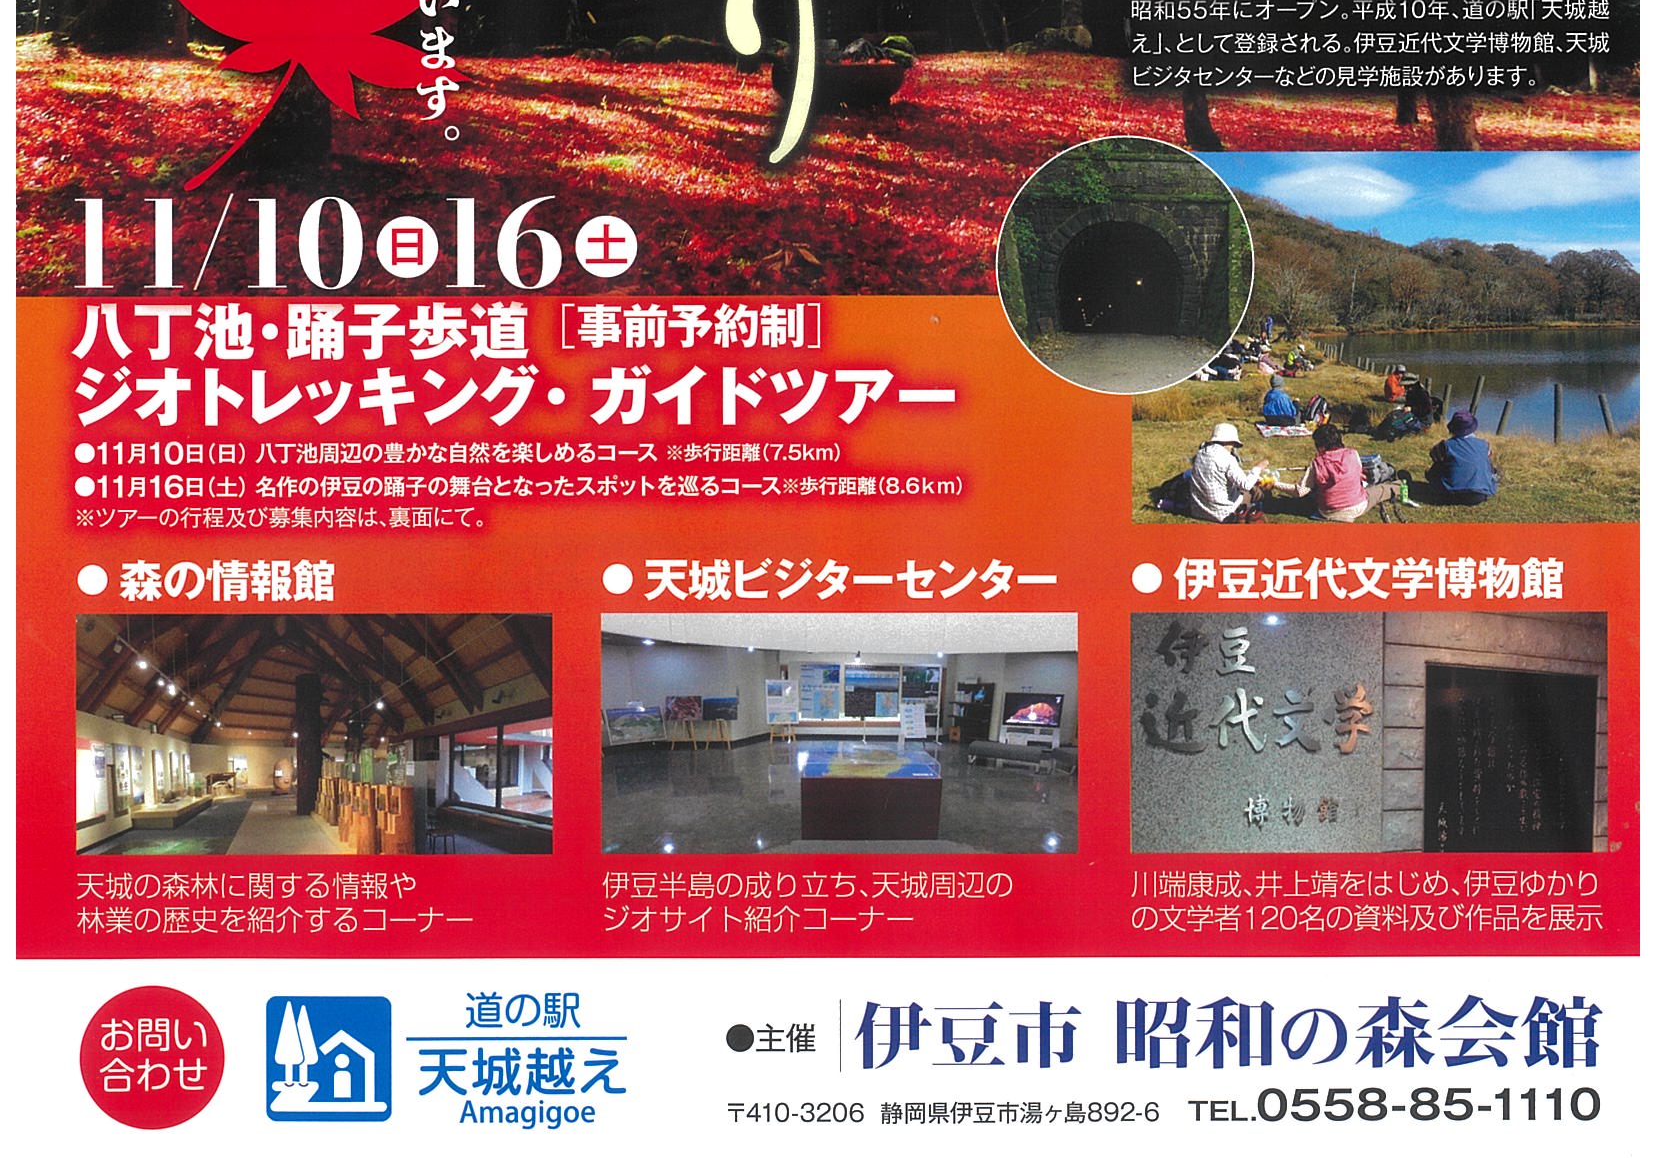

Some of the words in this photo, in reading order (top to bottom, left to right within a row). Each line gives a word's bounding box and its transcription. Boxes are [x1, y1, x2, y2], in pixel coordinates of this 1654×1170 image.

[1131, 31, 1611, 55] え」、として登録される。伊豆近代文学博物館、天城
[1132, 64, 1537, 88] ビジタセンターなどの見学施設があります。
[74, 193, 364, 291] 11/10
[445, 193, 563, 291] 16
[72, 302, 530, 361] 八丁池・踊子歩道
[256, 442, 658, 464] 八丁池周辺の豊かな自然を楽しめるコース
[76, 506, 485, 529] ※ツアーの行程及び募集内容は、裏面にて。
[119, 559, 336, 601] 森の情報館
[644, 558, 1057, 601] 天城ビジターセンター
[1174, 557, 1564, 600] 伊豆近代文学博物館
[1156, 621, 1256, 676] 伊豆
[1140, 683, 1374, 756] 近代文学
[76, 872, 417, 901] 天城の森林に関する情報や
[602, 872, 1014, 901] 伊豆半島の成り立ち、天城周辺の
[1131, 871, 1599, 900] 川端康成、井上靖をはじめ、伊豆ゆかり
[76, 906, 474, 934] 林業の歴史を紹介するコーナー
[602, 906, 915, 934] ジオサイト紹介コーナー
[1131, 904, 1603, 933] の文学者120名の資料及び作品を展示
[464, 992, 580, 1029] 道の駅
[99, 1019, 208, 1052] お問い
[756, 1024, 816, 1053] 主催
[855, 1000, 1082, 1070] 伊豆市
[1116, 995, 1603, 1069] 昭和の森会館
[99, 1057, 209, 1093] 合わせ
[418, 1046, 628, 1096] 天城越え
[458, 1099, 596, 1130] Amagigoe
[727, 1101, 865, 1125] 〒410-3206
[880, 1101, 1160, 1125] 静岡県伊豆市湯ヶ島892-6
